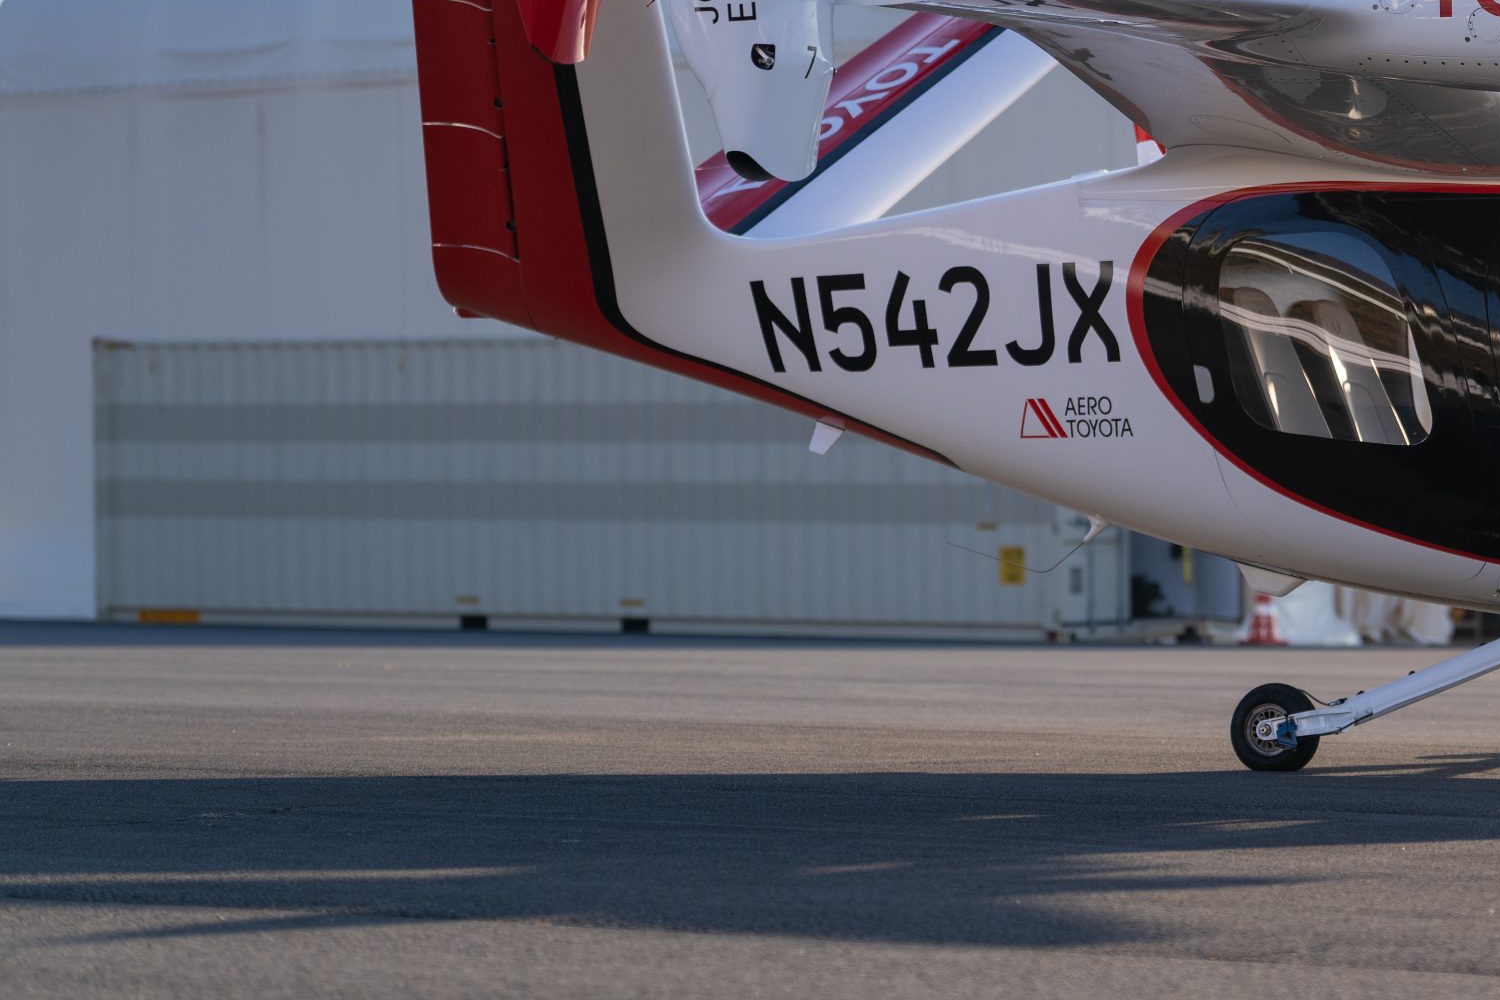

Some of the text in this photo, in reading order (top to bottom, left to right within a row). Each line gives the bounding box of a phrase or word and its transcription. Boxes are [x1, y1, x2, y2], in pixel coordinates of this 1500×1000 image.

[749, 260, 1122, 373] N542JX
[1064, 396, 1112, 417] AERO
[1066, 418, 1134, 438] TOYOTA
